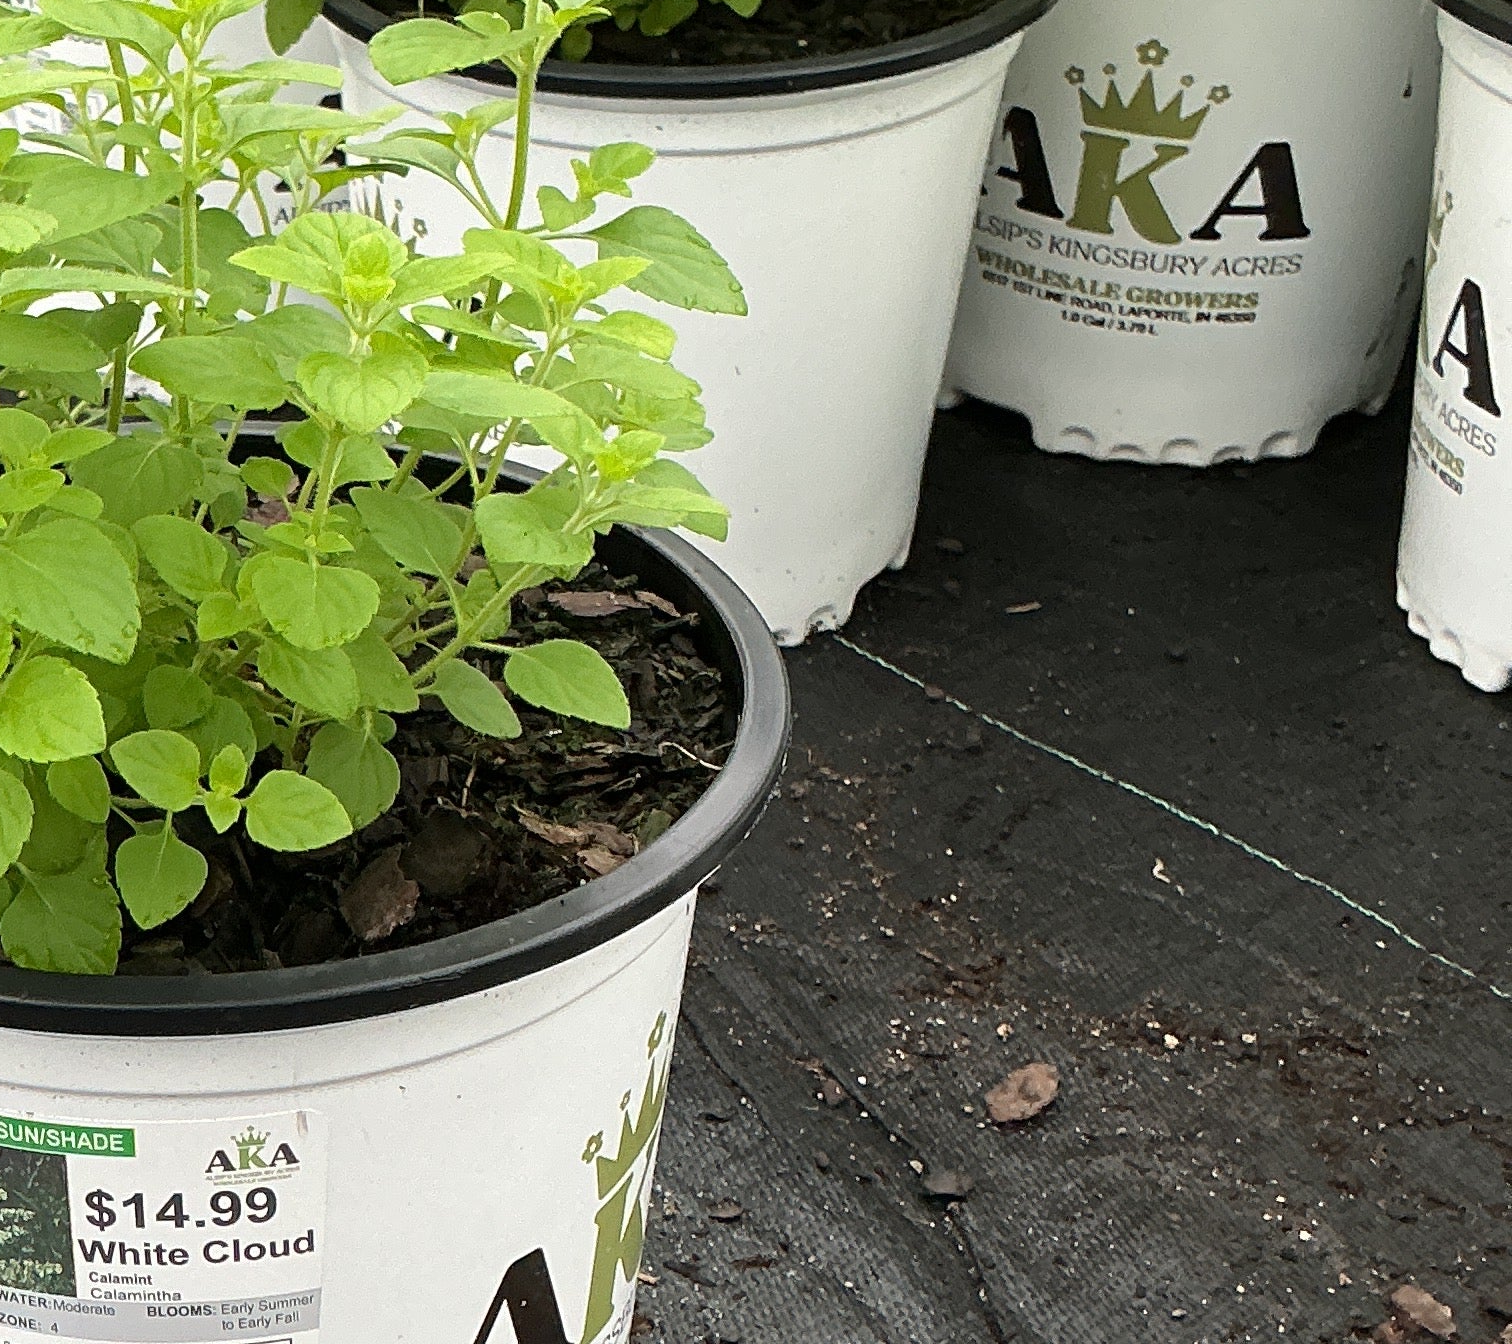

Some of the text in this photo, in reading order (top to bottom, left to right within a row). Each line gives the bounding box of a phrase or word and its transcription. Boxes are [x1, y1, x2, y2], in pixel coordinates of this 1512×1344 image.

[982, 106, 1311, 245] AKA
[976, 215, 1303, 277] LSIP'S KINGSBURY ACRES
[976, 244, 1260, 309] WHOLESALE GROWERS
[1439, 403, 1496, 457] ACRES
[205, 1143, 300, 1173] AKA
[85, 1187, 277, 1231] $14.99
[77, 1229, 315, 1266] White Cloud
[89, 1271, 153, 1286] Calamint
[53, 1299, 116, 1316] Moderate
[90, 1287, 182, 1302] Calamintha
[147, 1294, 314, 1317] BLOOMS: Early Summer
[50, 1322, 58, 1333] 4
[222, 1311, 300, 1330] to Early Fall
